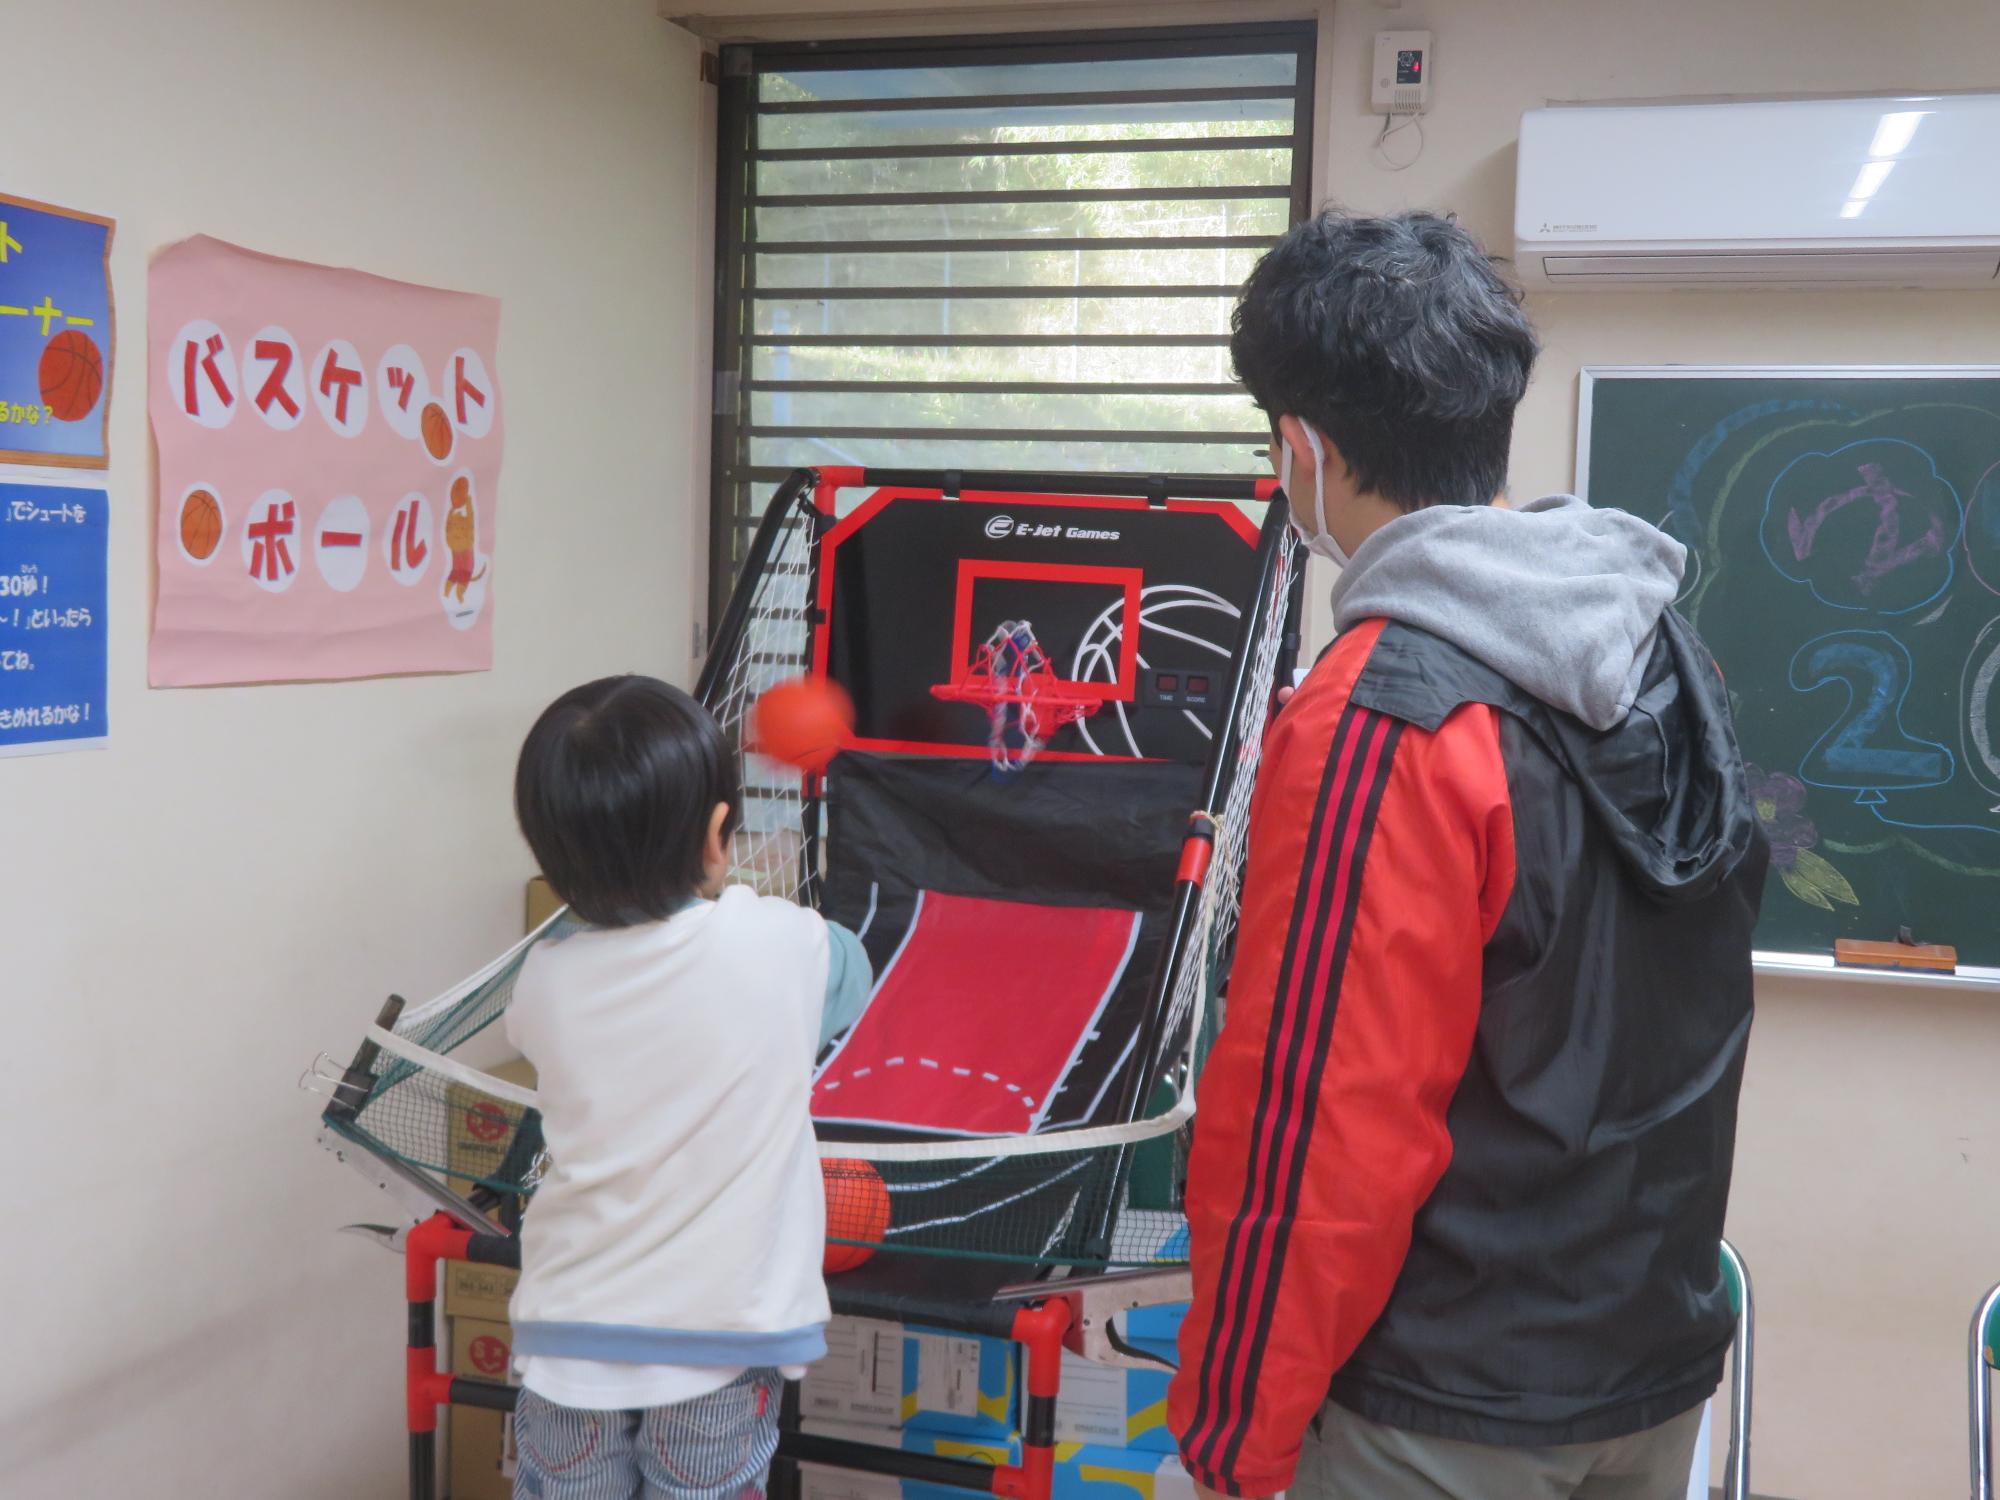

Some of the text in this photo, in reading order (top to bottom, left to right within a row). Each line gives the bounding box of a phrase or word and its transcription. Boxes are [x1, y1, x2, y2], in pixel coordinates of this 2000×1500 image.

[184, 333, 486, 425] バスケット
[247, 500, 427, 581] ボール
[1066, 527, 1120, 540] Games
